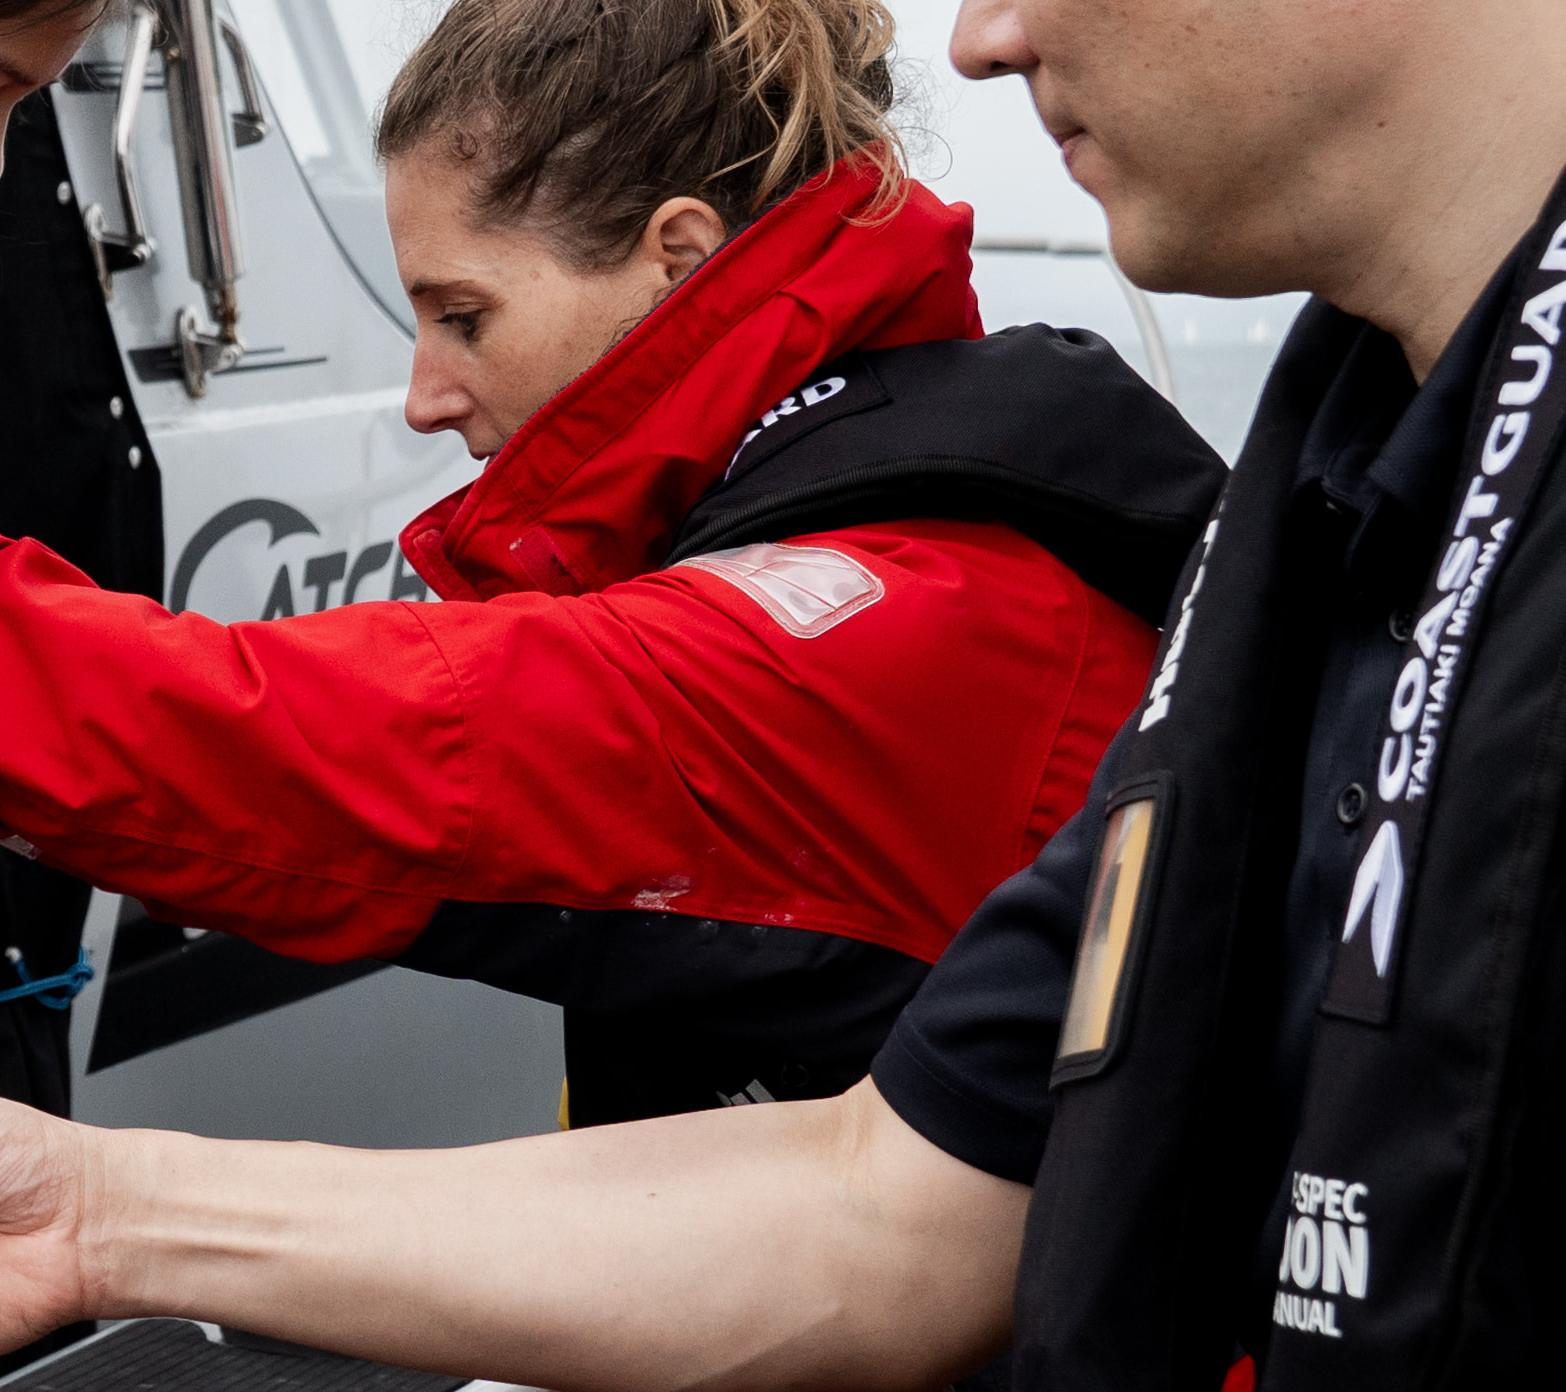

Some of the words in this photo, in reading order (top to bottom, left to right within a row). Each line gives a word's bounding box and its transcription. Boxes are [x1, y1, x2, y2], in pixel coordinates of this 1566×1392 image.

[1406, 644, 1462, 802] TAUTIAKI
[1445, 516, 1515, 637] MOANA
[1292, 1170, 1369, 1225] SPEC
